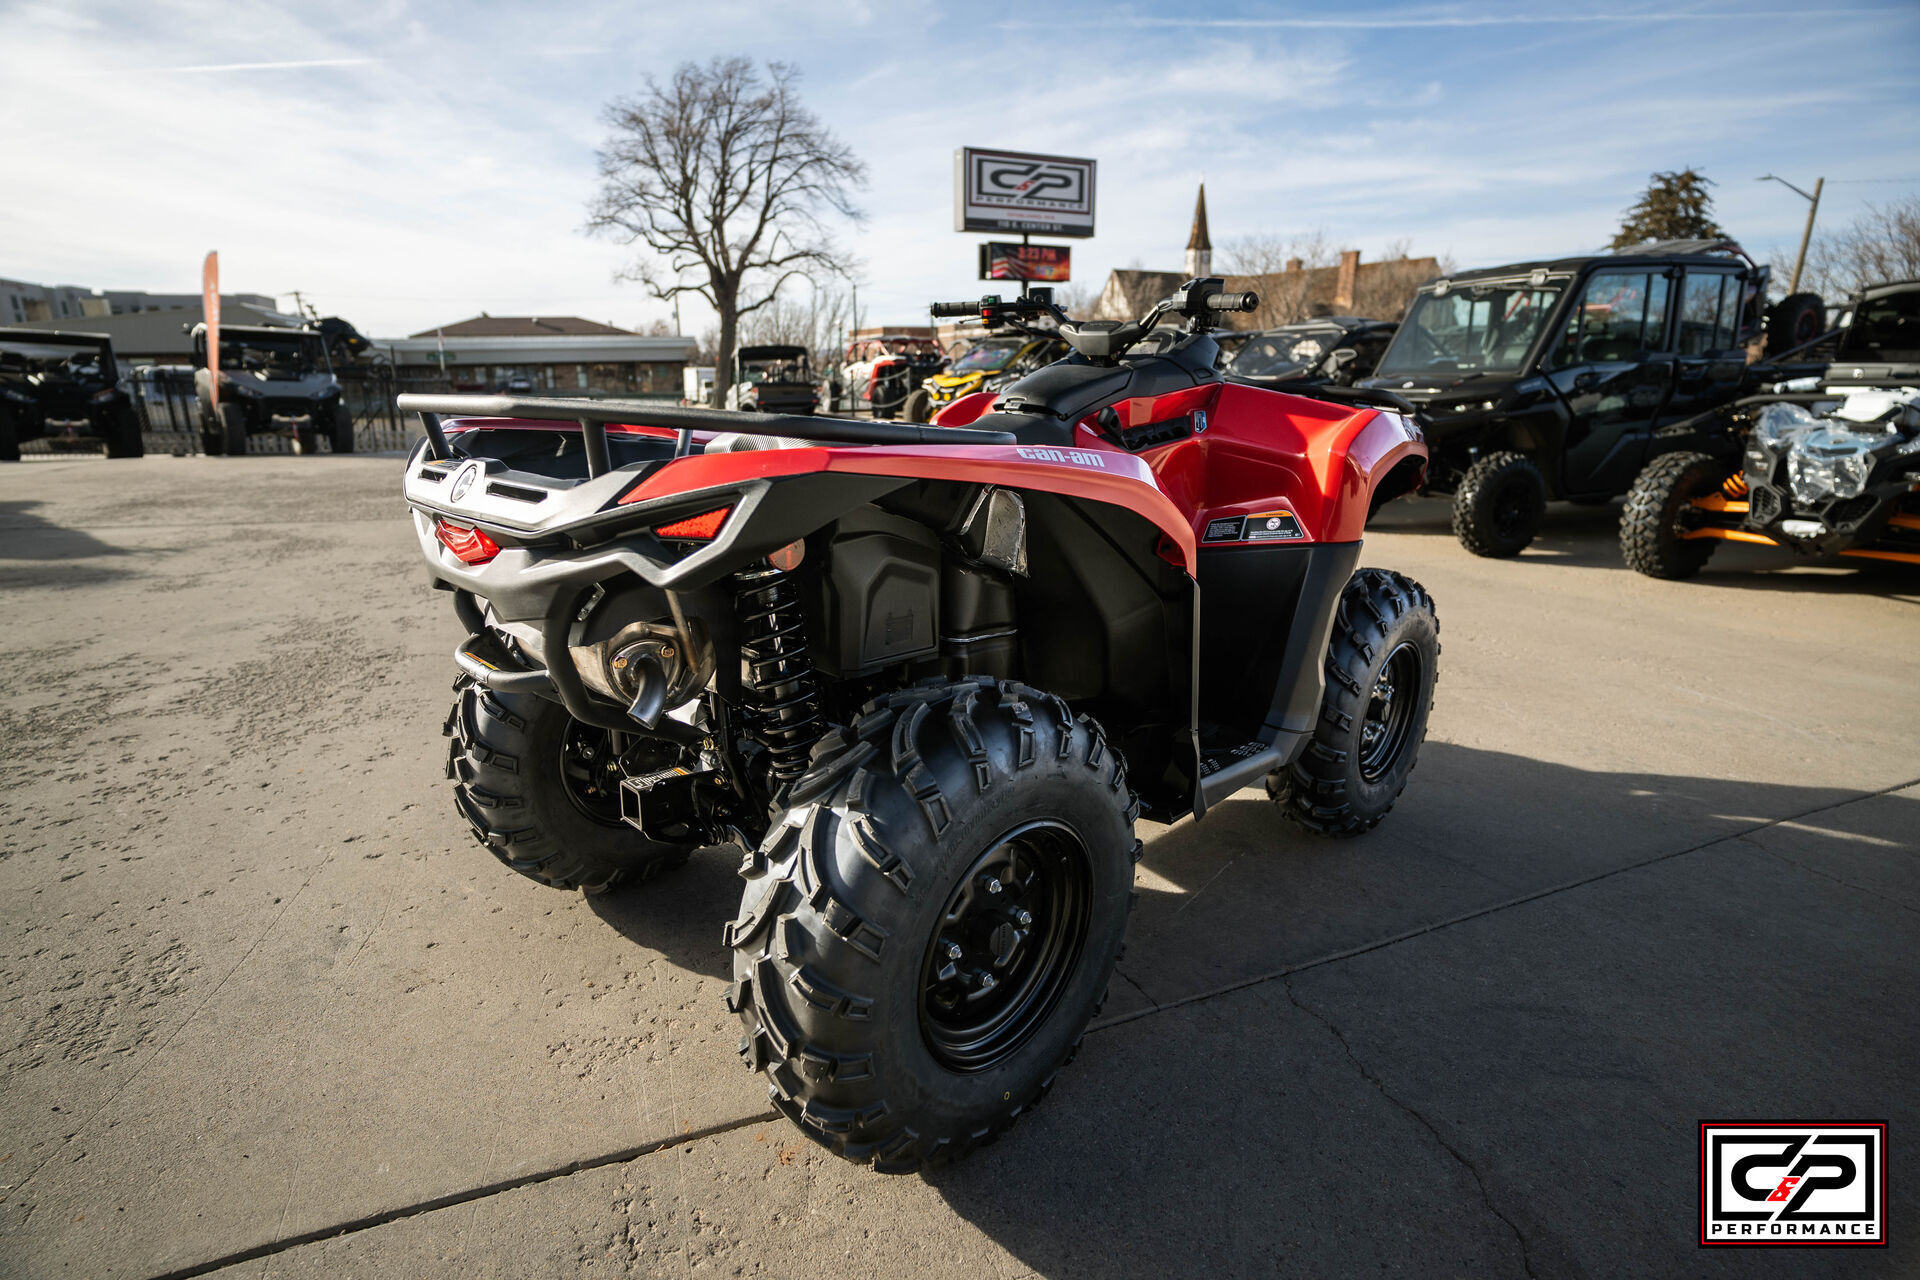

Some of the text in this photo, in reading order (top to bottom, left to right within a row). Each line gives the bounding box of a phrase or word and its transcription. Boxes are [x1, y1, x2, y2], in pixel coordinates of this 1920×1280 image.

[975, 195, 1084, 209] PERFORMANCE
[1041, 248, 1057, 261] PM
[1017, 448, 1105, 467] can-am
